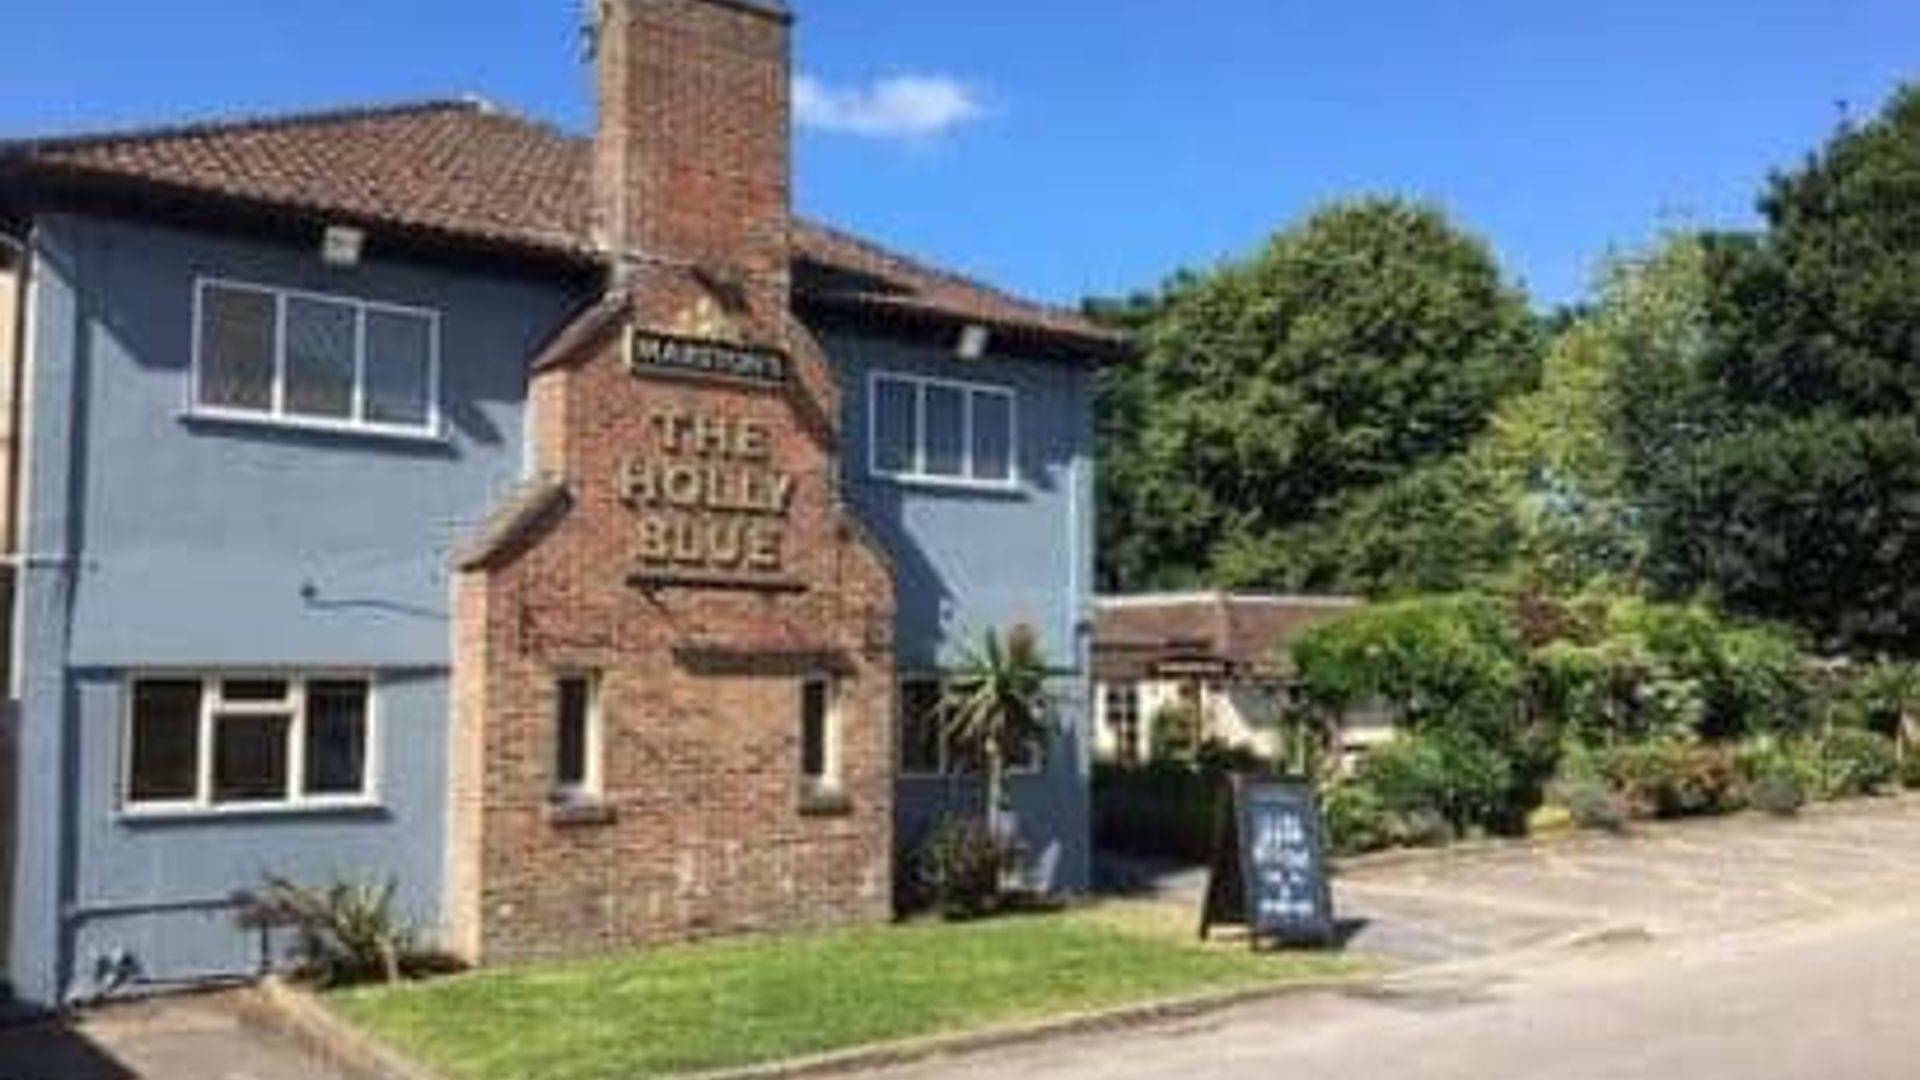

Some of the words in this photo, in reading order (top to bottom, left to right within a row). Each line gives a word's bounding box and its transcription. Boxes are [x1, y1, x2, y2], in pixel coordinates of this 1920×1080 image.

[652, 408, 771, 456] THE
[620, 457, 795, 512] HOLLY
[638, 515, 780, 567] BLUE
